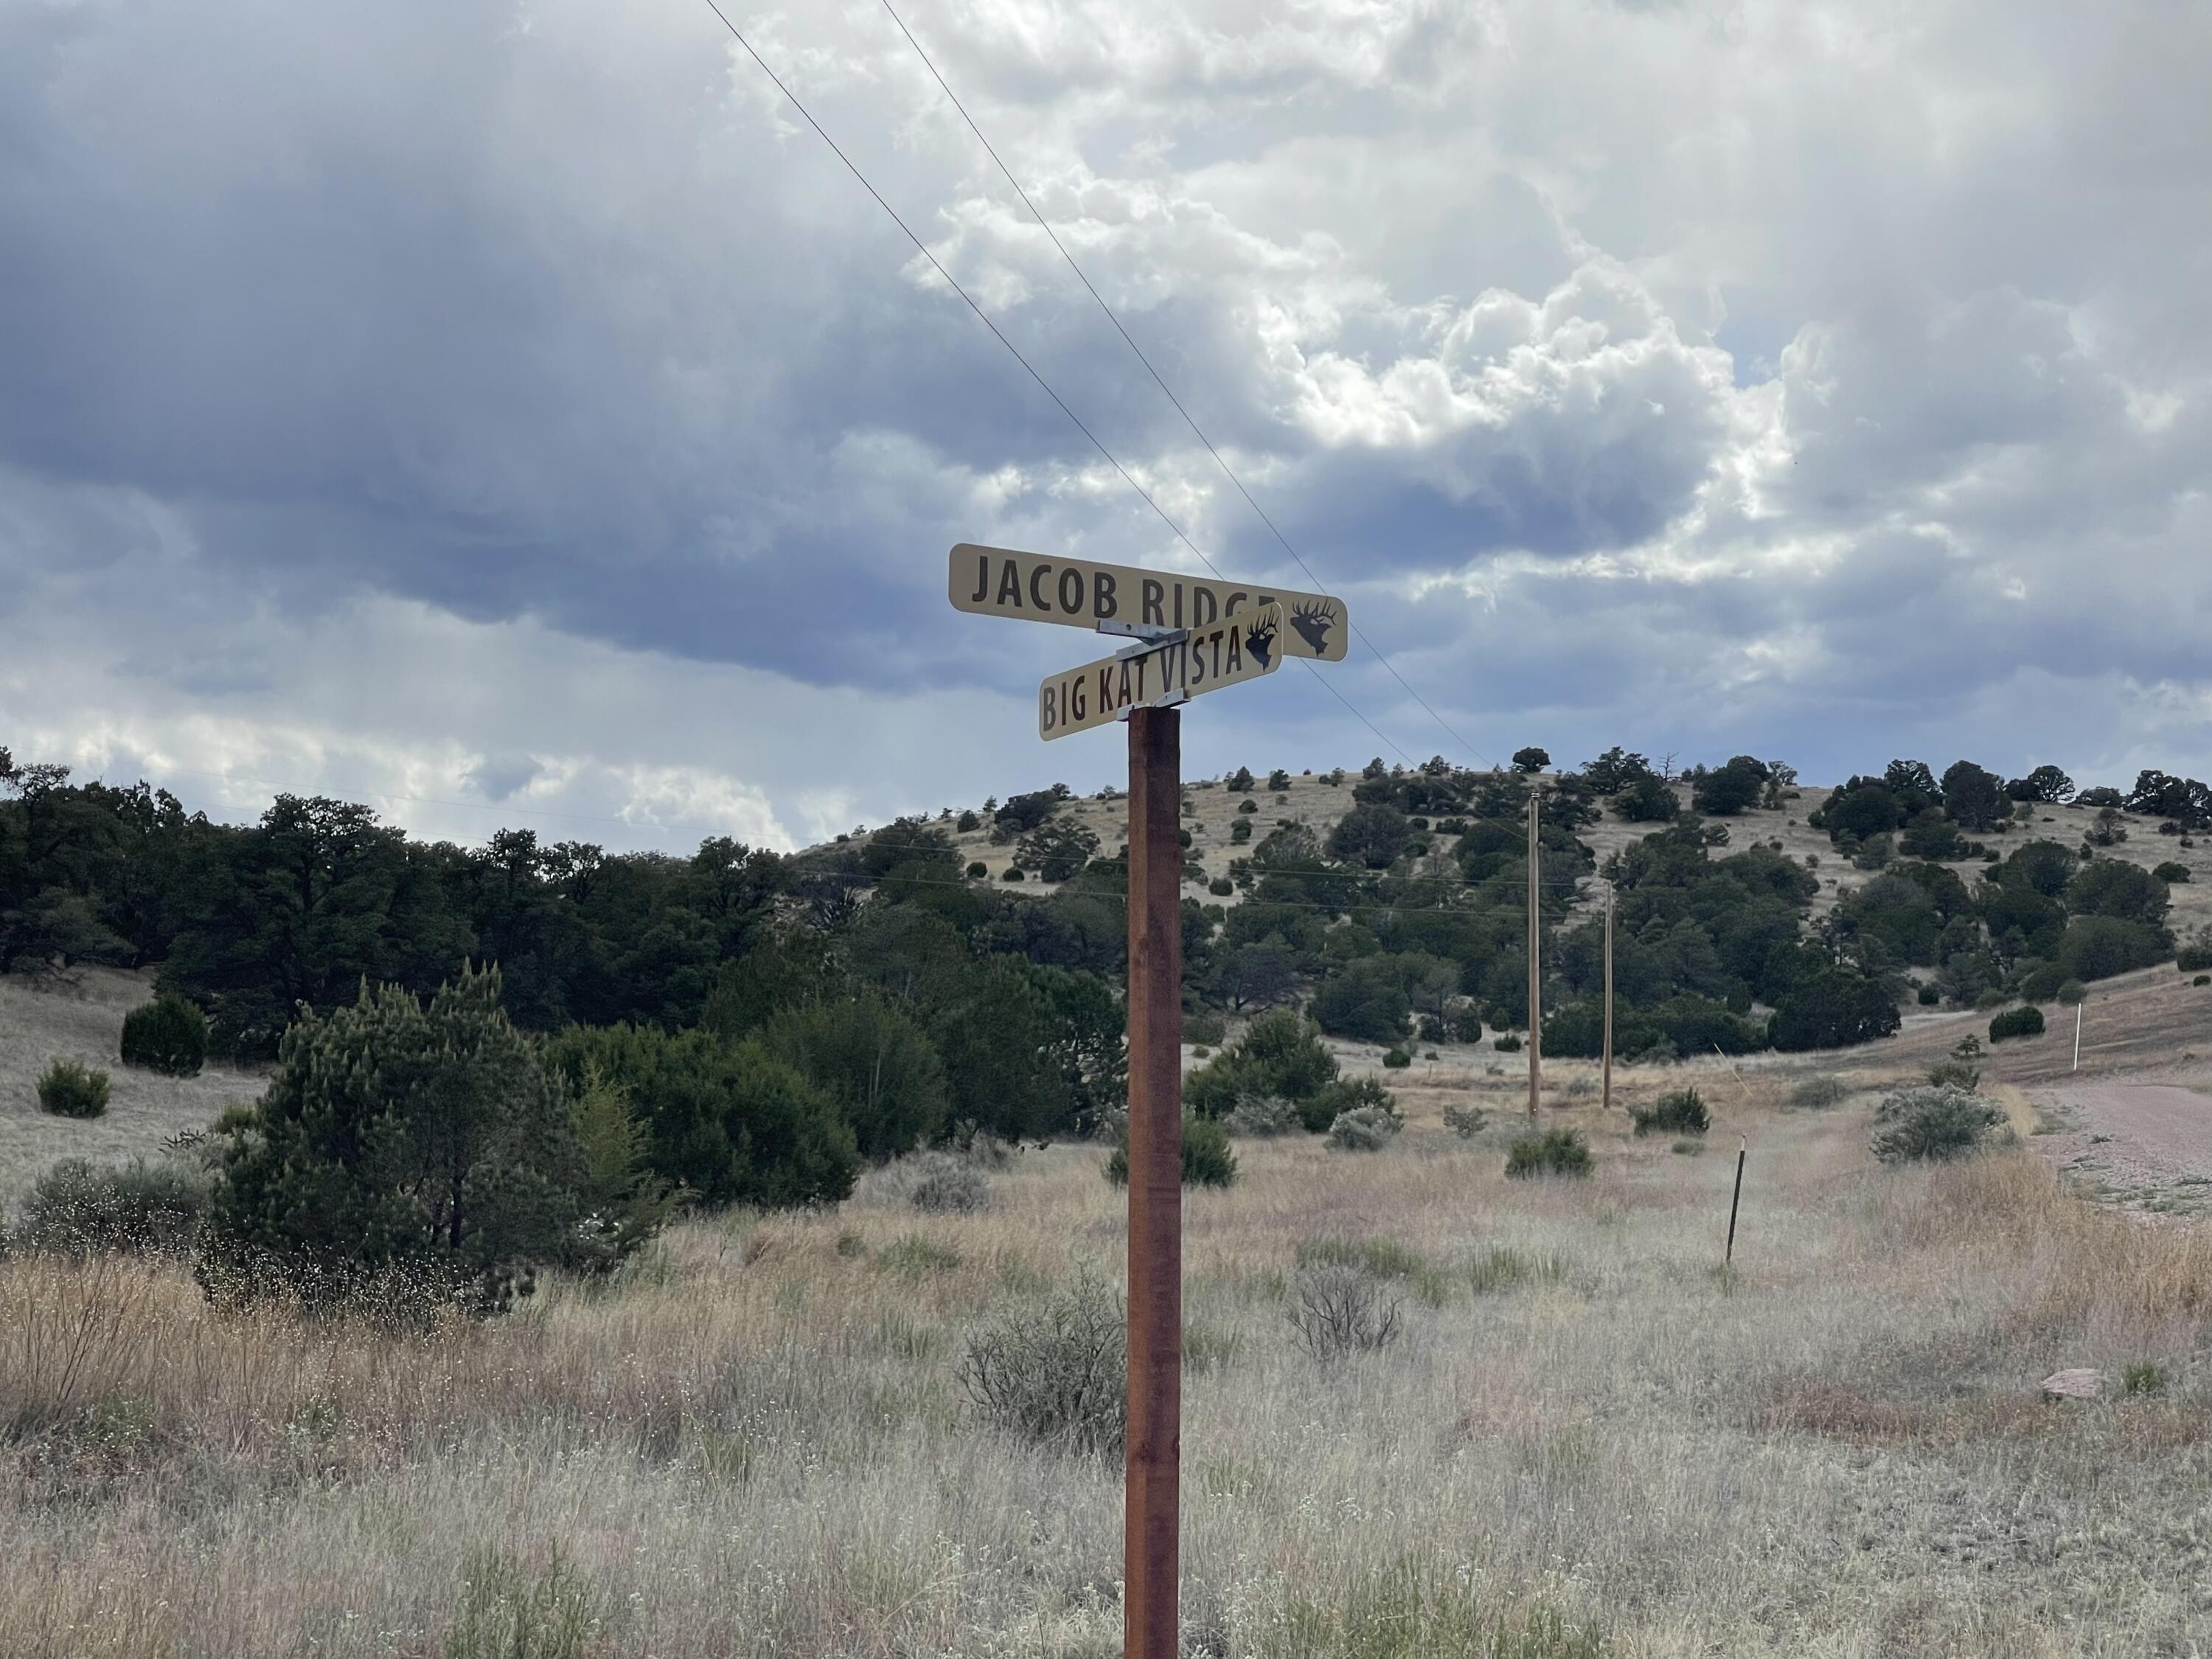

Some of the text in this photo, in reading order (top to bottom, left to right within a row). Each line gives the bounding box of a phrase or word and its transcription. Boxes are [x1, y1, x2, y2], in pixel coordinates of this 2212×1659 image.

[972, 555, 1275, 630] JACOB RID
[1043, 625, 1242, 732] BIG KAT VISTA
